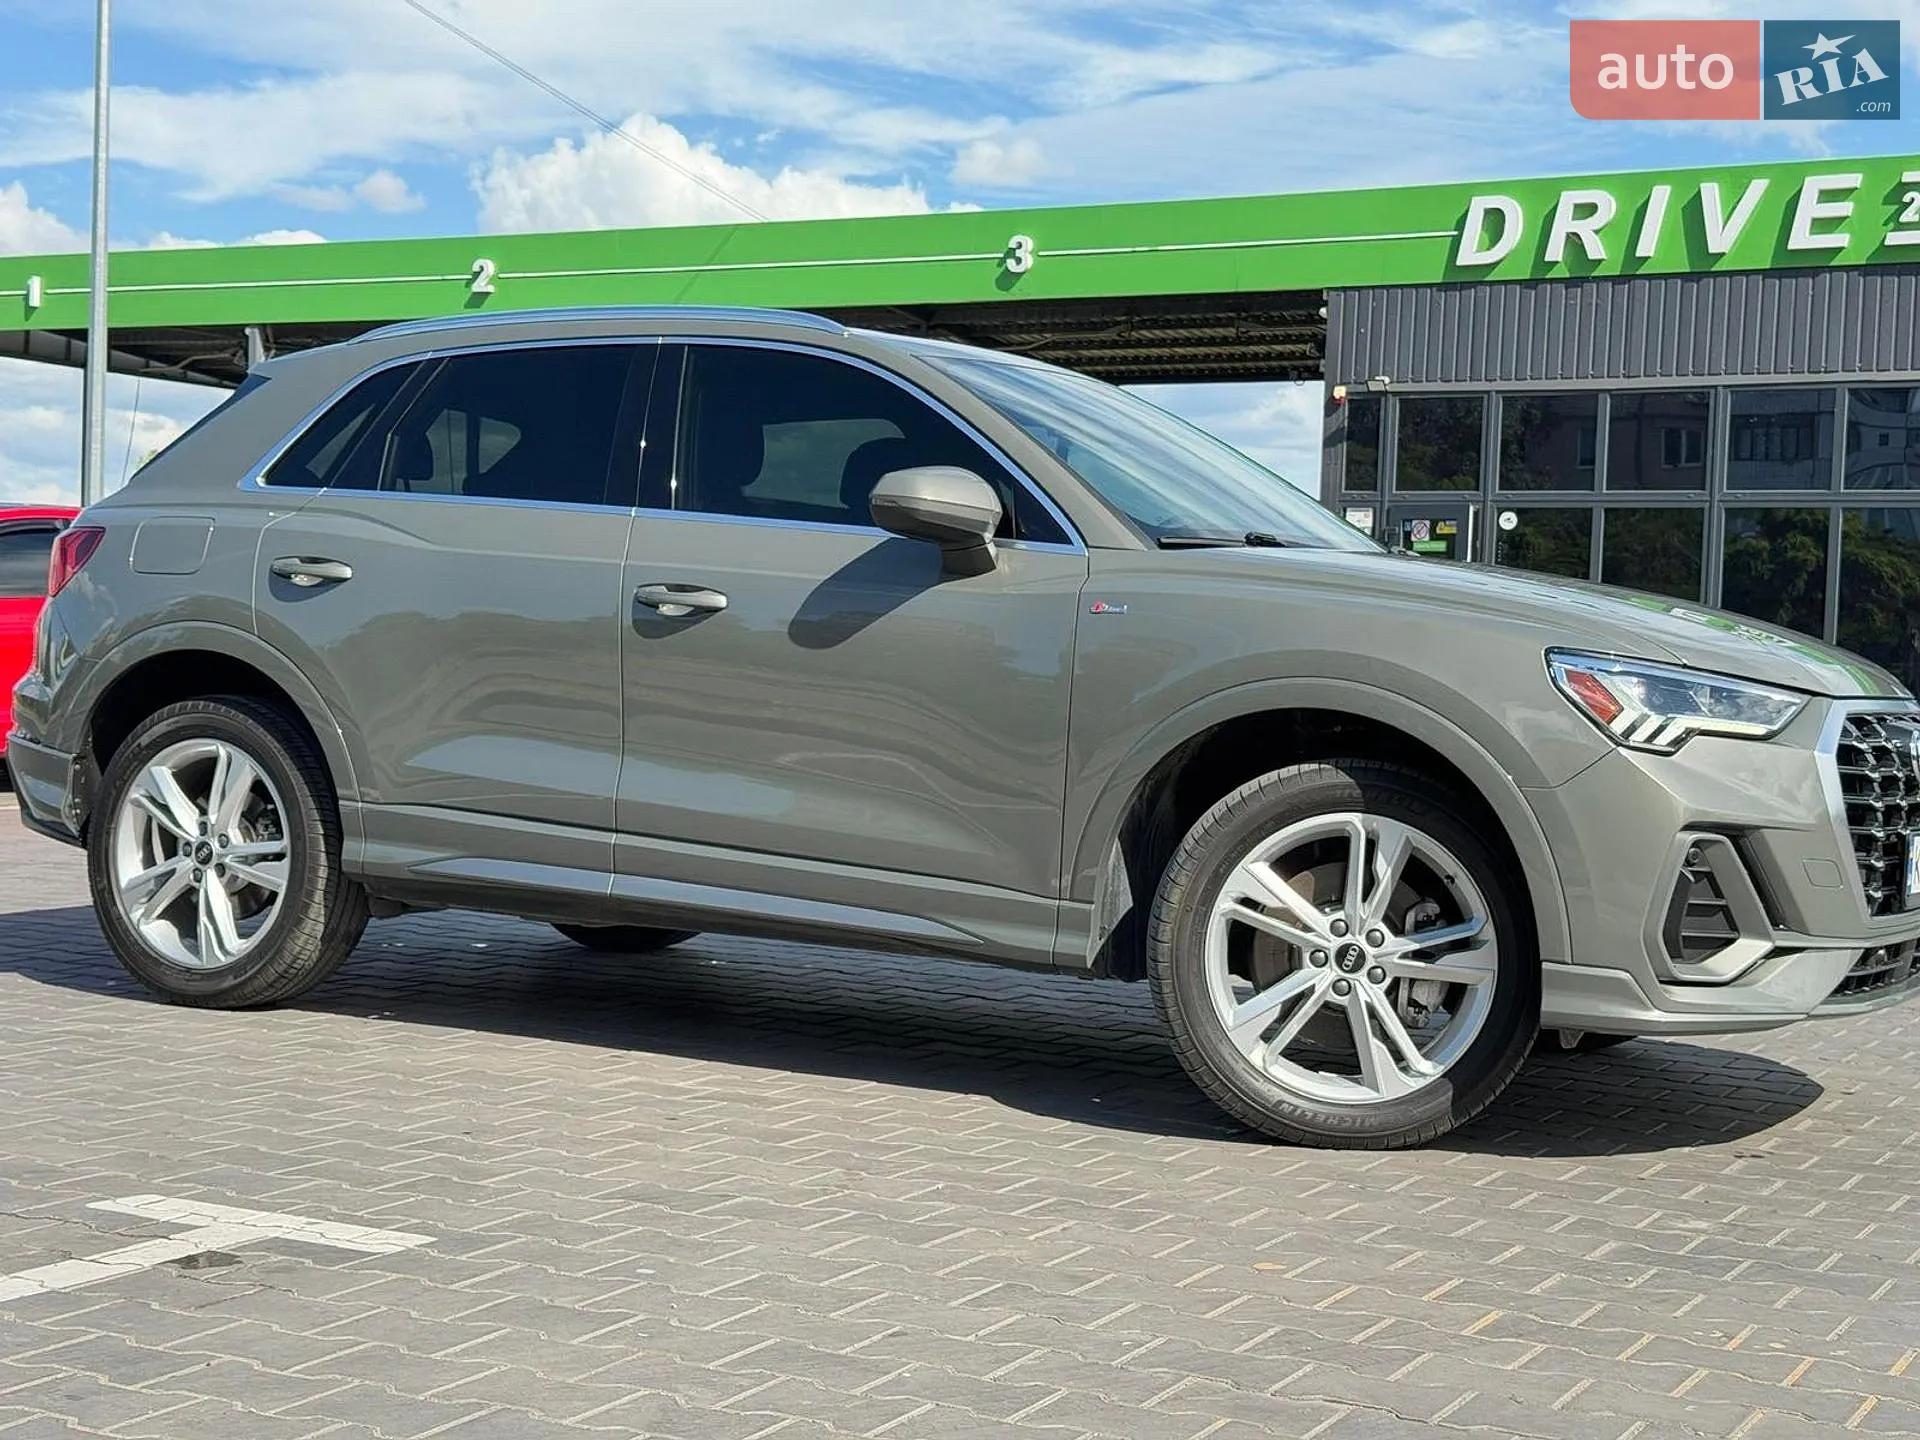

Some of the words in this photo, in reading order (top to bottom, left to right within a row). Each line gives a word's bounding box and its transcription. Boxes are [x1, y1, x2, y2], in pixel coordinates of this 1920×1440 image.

[1455, 173, 1864, 267] DRIVE
[1006, 234, 1034, 273] 3
[27, 275, 41, 307] 1
[471, 258, 495, 293] 2
